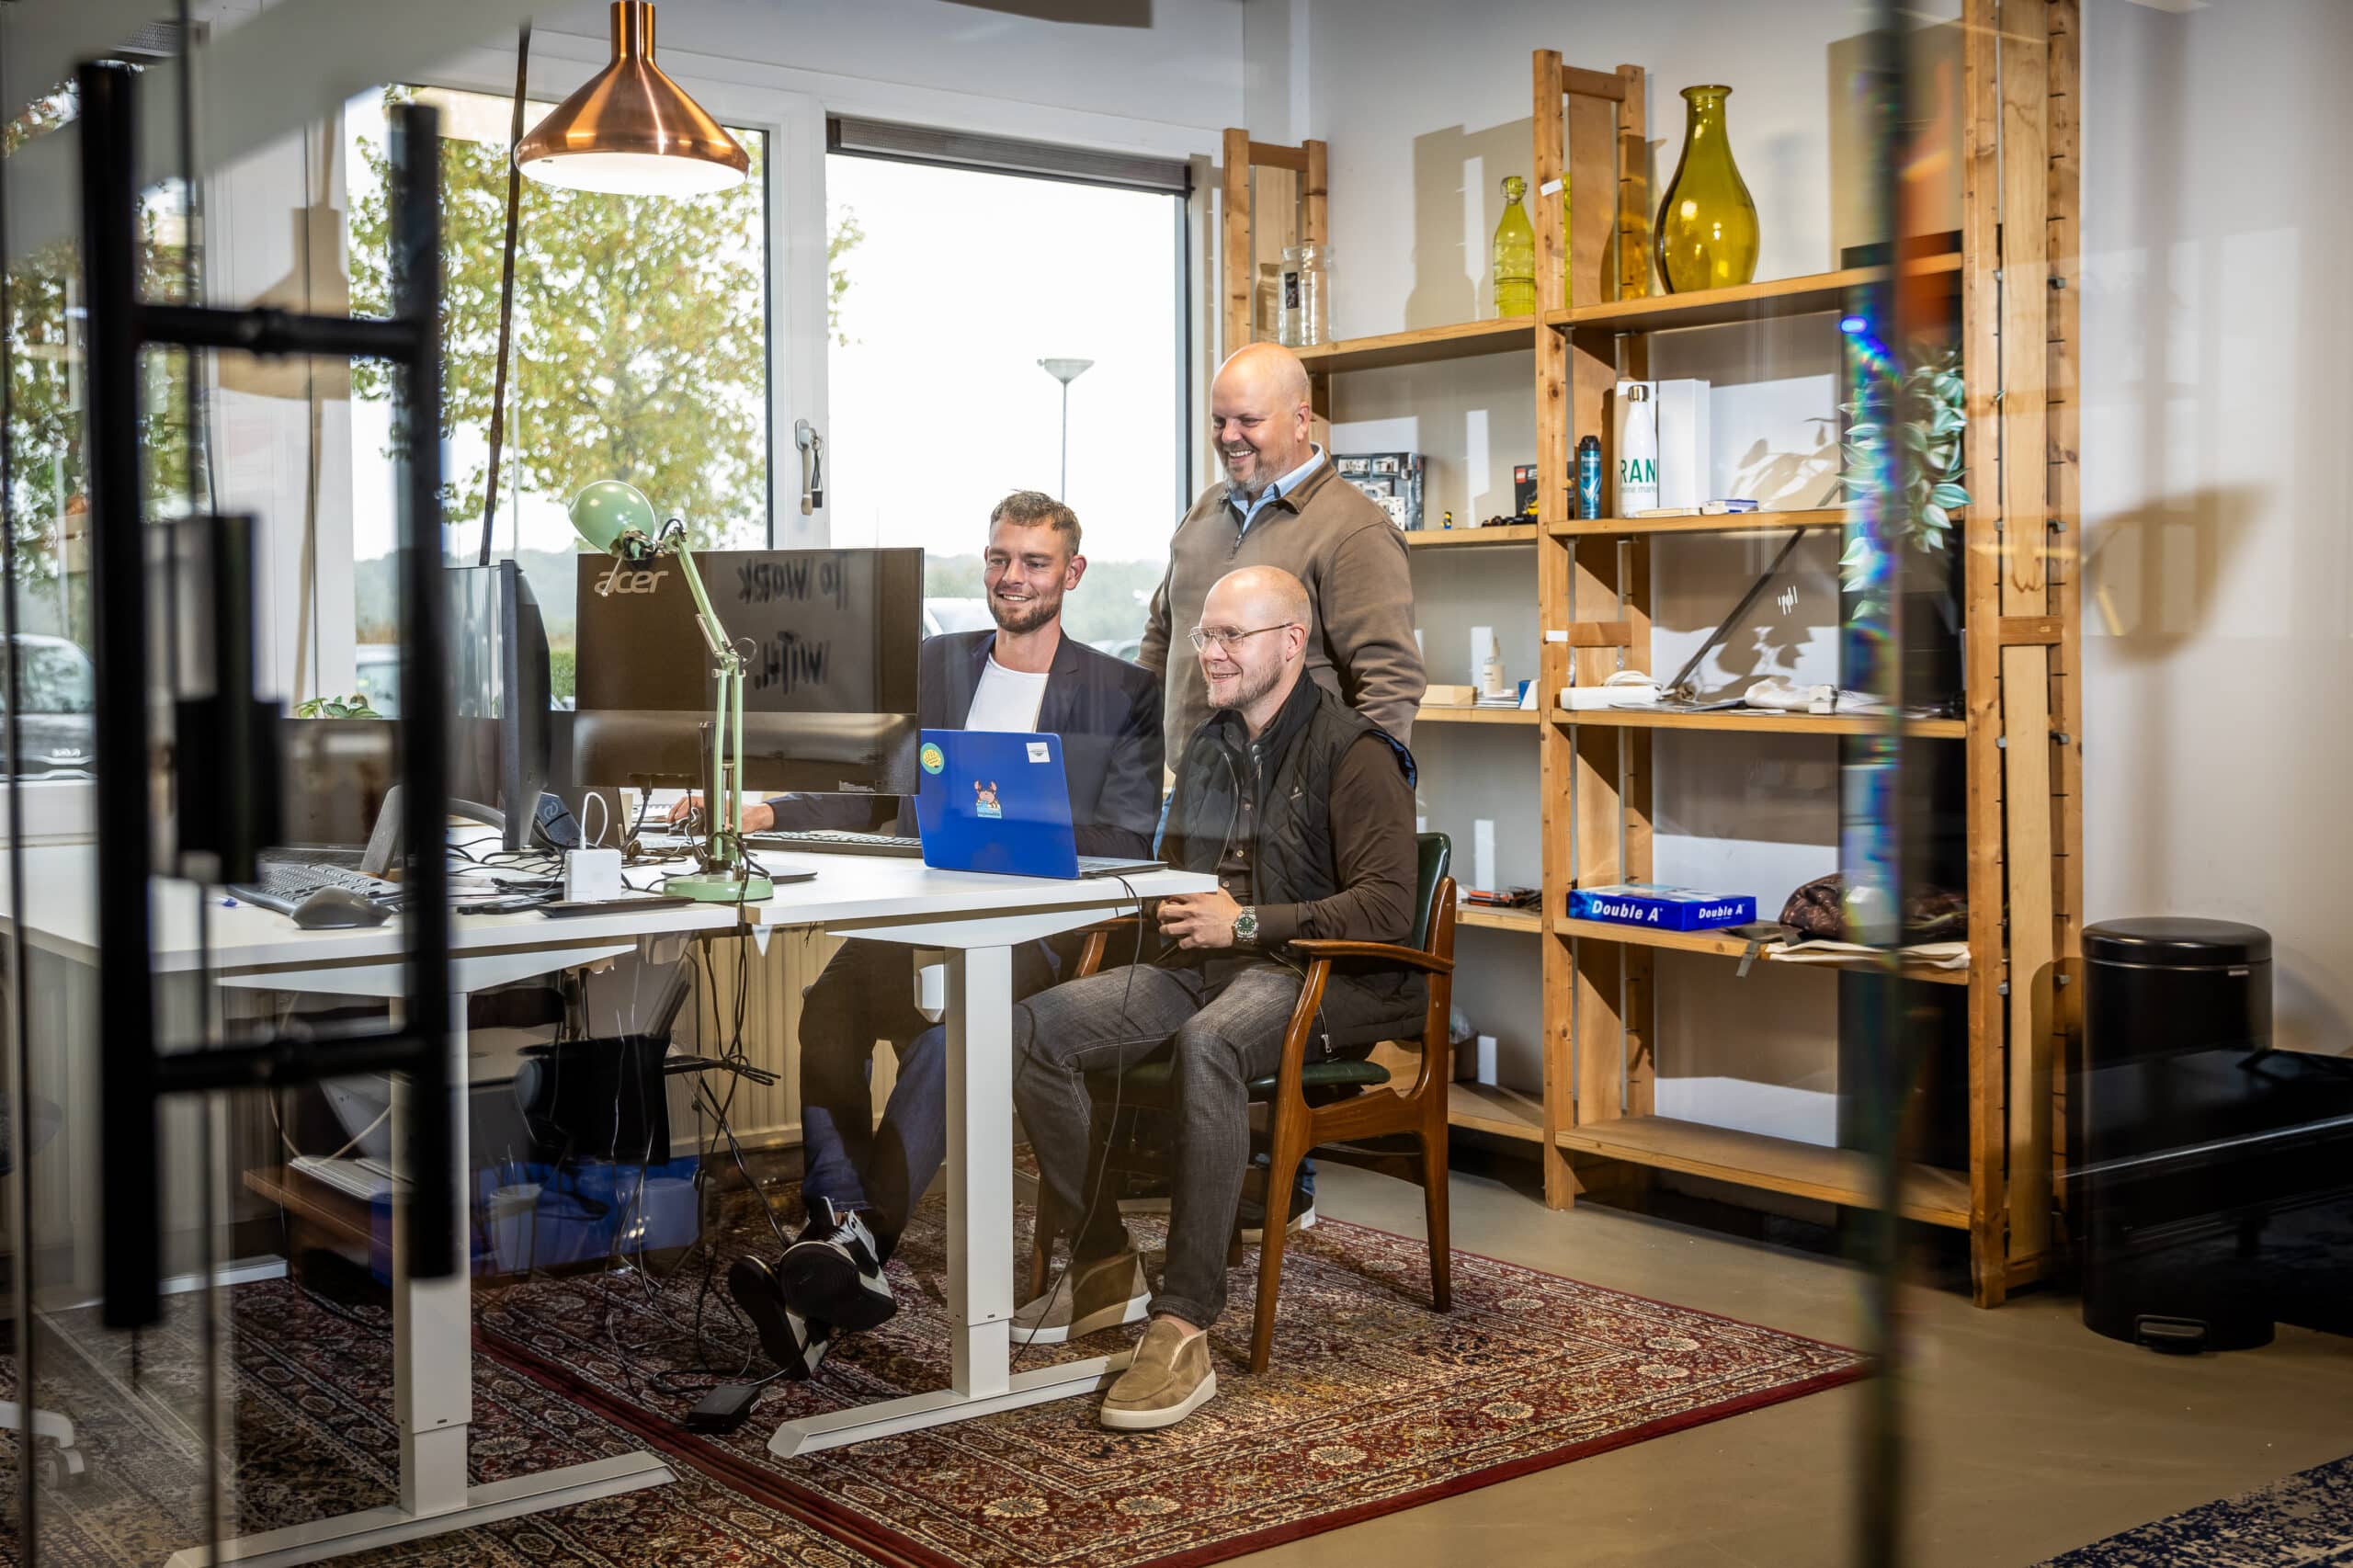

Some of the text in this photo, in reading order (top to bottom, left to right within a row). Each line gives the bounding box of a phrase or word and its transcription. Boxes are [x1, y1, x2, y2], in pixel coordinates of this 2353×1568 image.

[594, 571, 668, 594] acer
[1592, 900, 1643, 920] Double
[1699, 905, 1733, 919] Double
